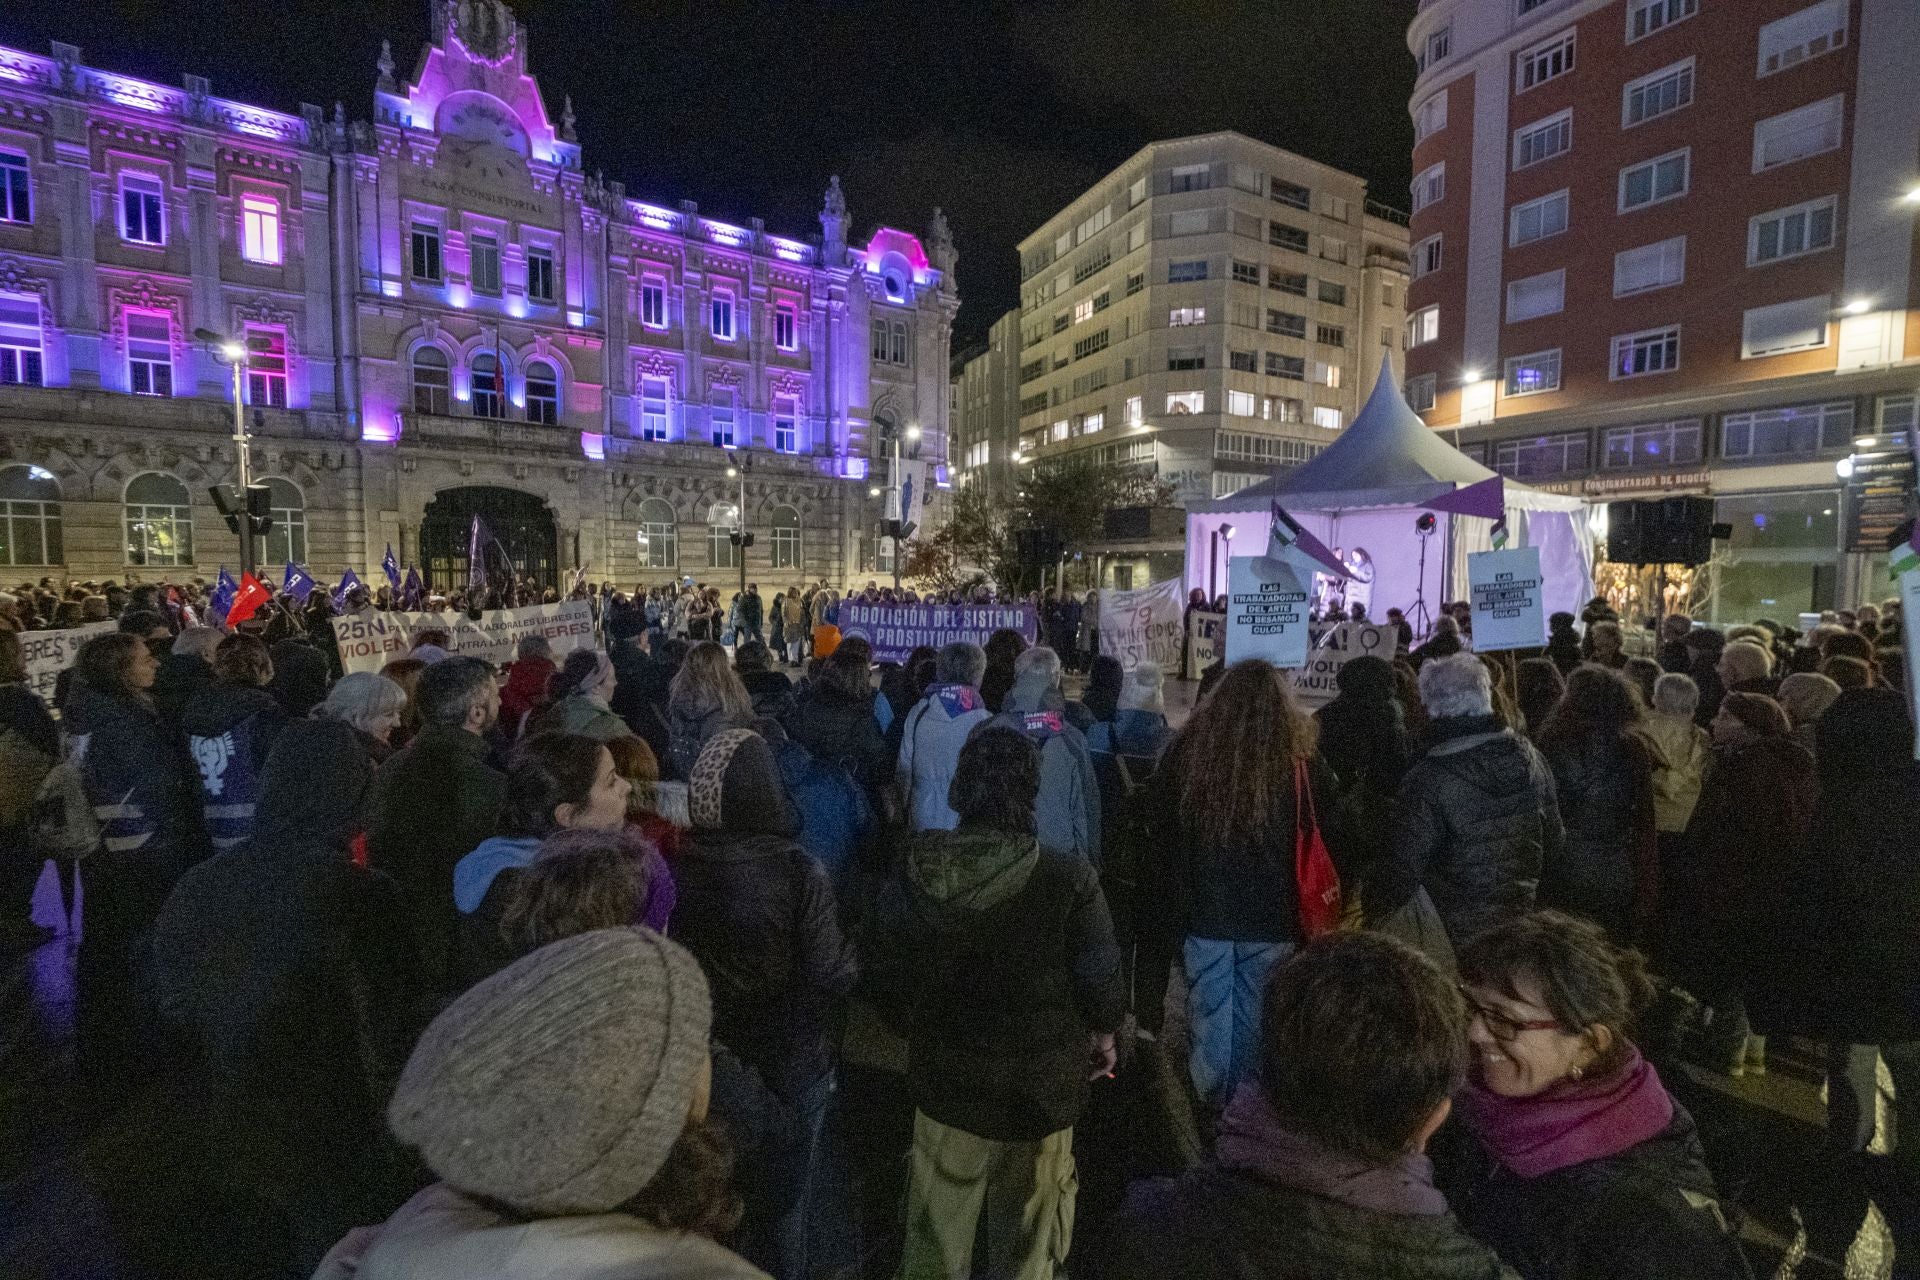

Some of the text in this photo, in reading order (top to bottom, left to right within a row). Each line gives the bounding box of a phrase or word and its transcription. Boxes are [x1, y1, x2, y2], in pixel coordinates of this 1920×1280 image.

[1585, 473, 1711, 490] CONSIGNATARIOS DE BUQUES
[1262, 584, 1278, 592] LAS
[1235, 593, 1305, 603] TRABAJADORAS
[1248, 604, 1290, 613] DEL ARTE
[850, 606, 1024, 628] ABOLICIÓN DEL SISTEMA
[1240, 614, 1297, 624] NO BESAMOS
[338, 619, 386, 641] 25N
[574, 611, 588, 620] DE
[1253, 625, 1282, 634] CULOS
[876, 628, 993, 648] PROSTITUCIONA
[340, 639, 405, 658] VIOLEN
[490, 638, 508, 647] LAS
[1295, 676, 1336, 690] MUJE
